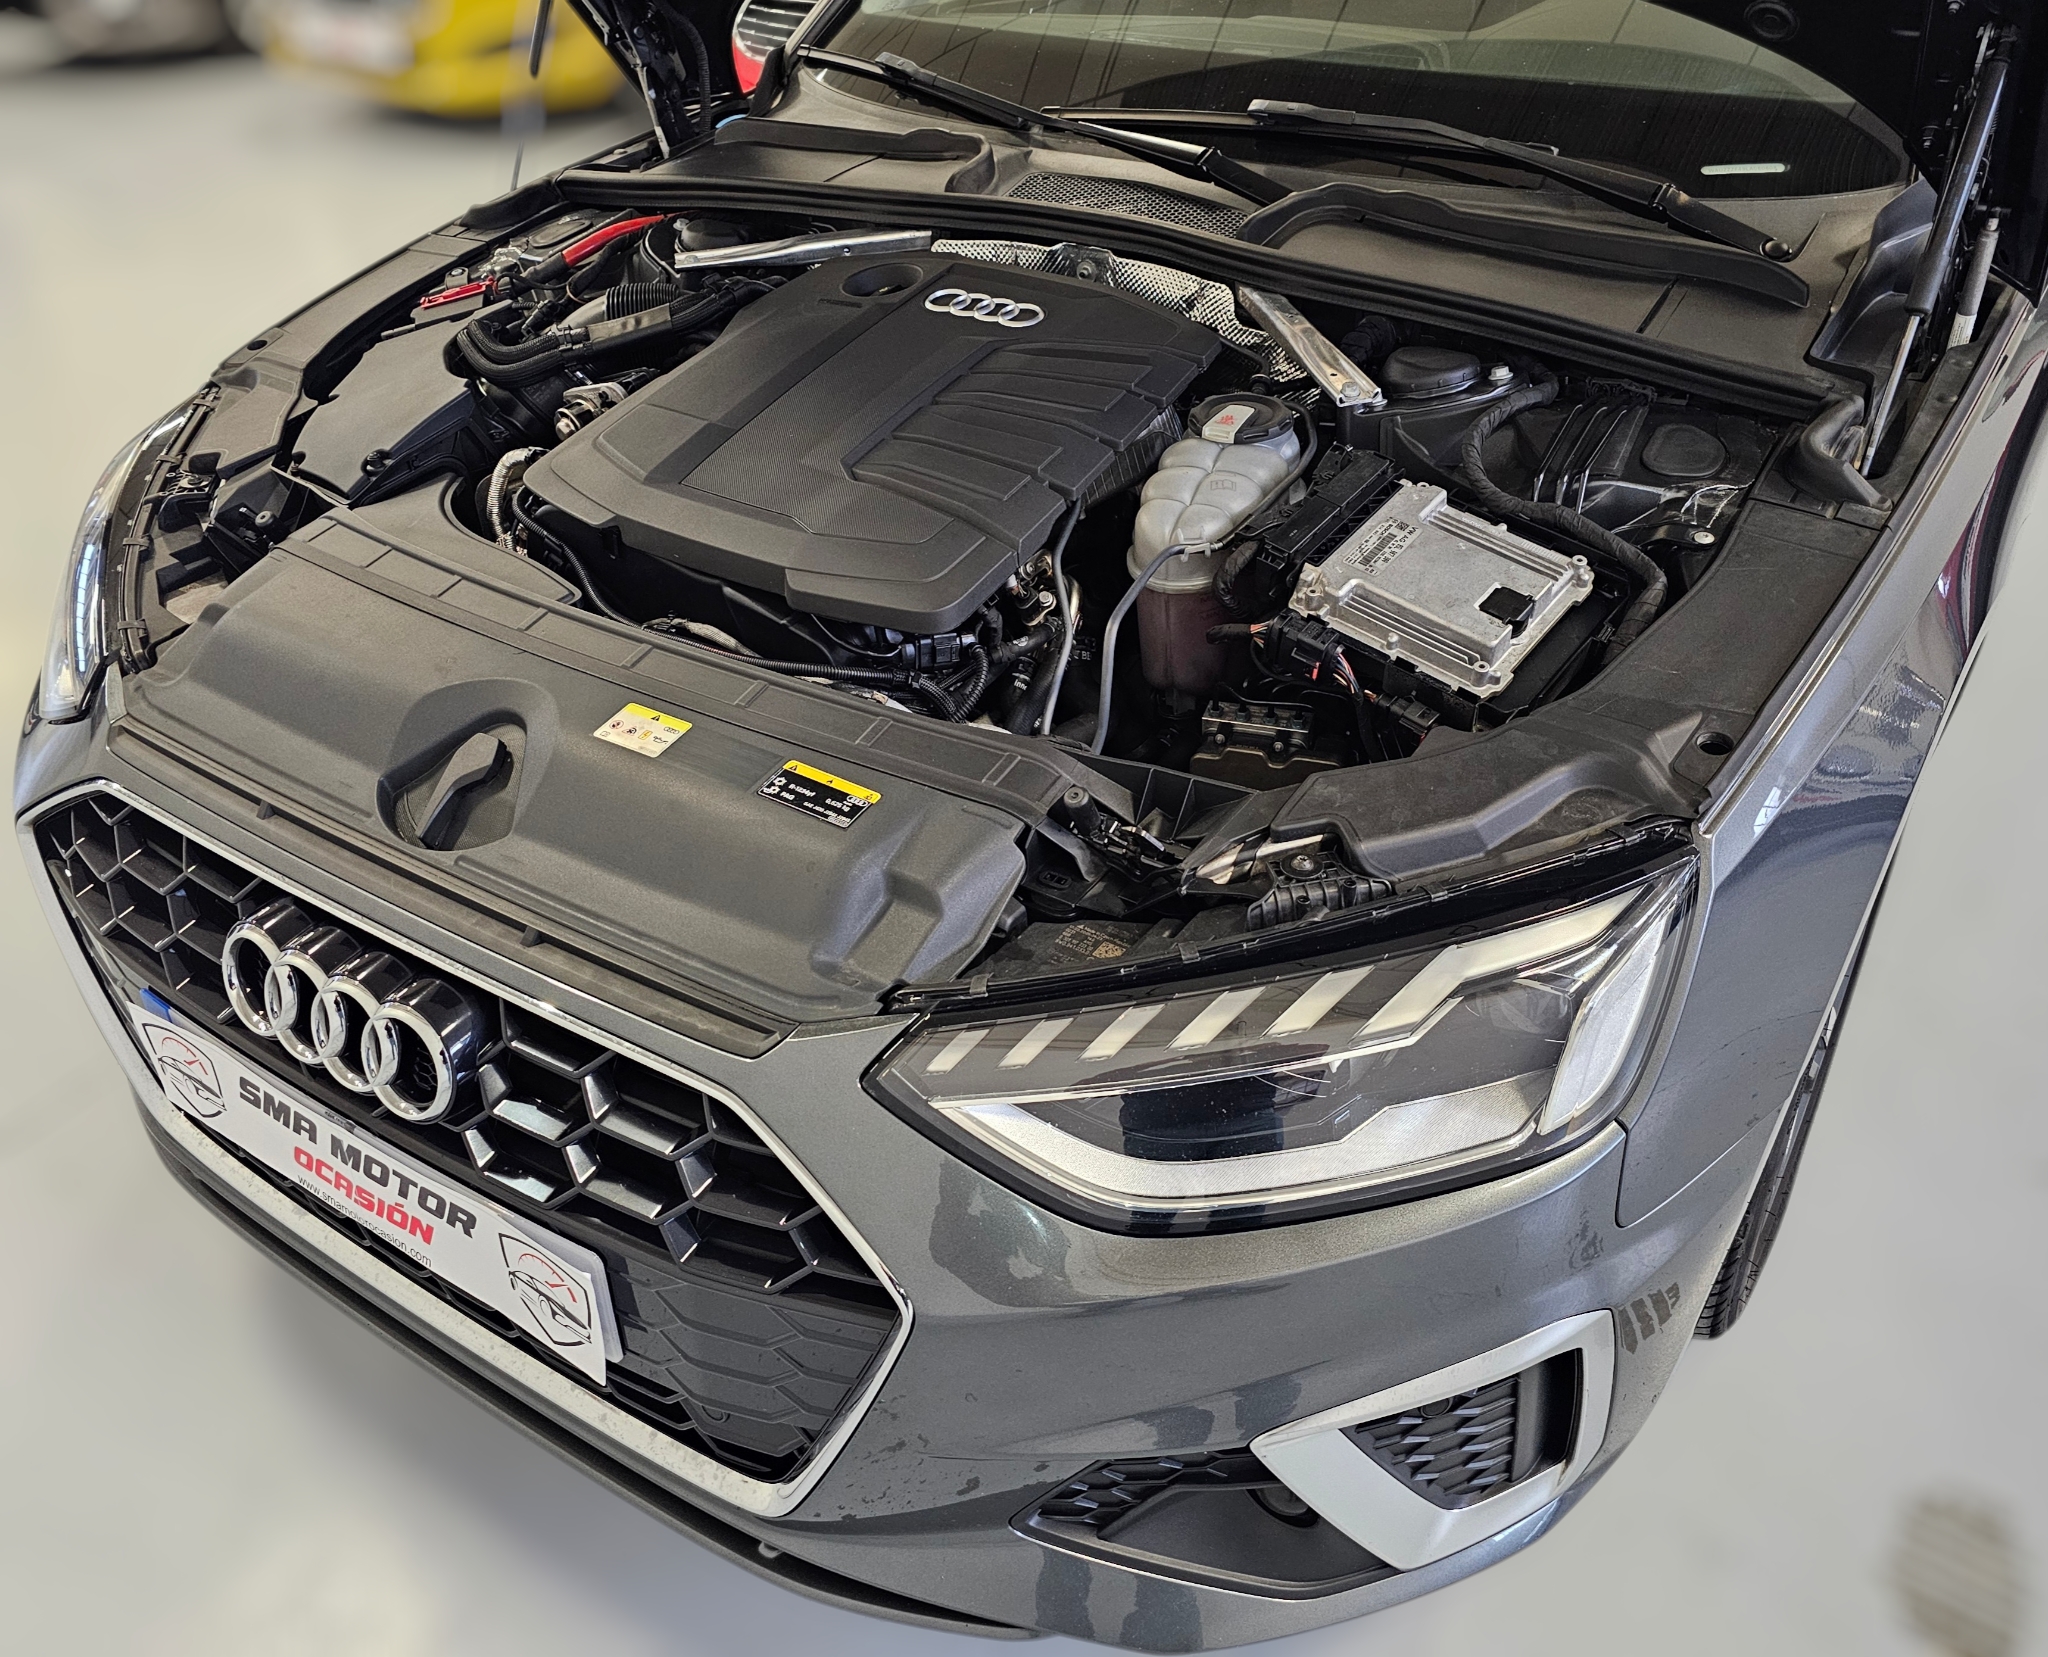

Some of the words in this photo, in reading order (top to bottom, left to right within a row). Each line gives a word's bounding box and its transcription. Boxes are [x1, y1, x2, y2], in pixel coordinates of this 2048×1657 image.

[1380, 523, 1394, 536] BOSCH
[239, 1076, 318, 1144] SMA
[330, 1133, 478, 1239] MOTOR
[293, 1145, 435, 1246] OCASIÓN
